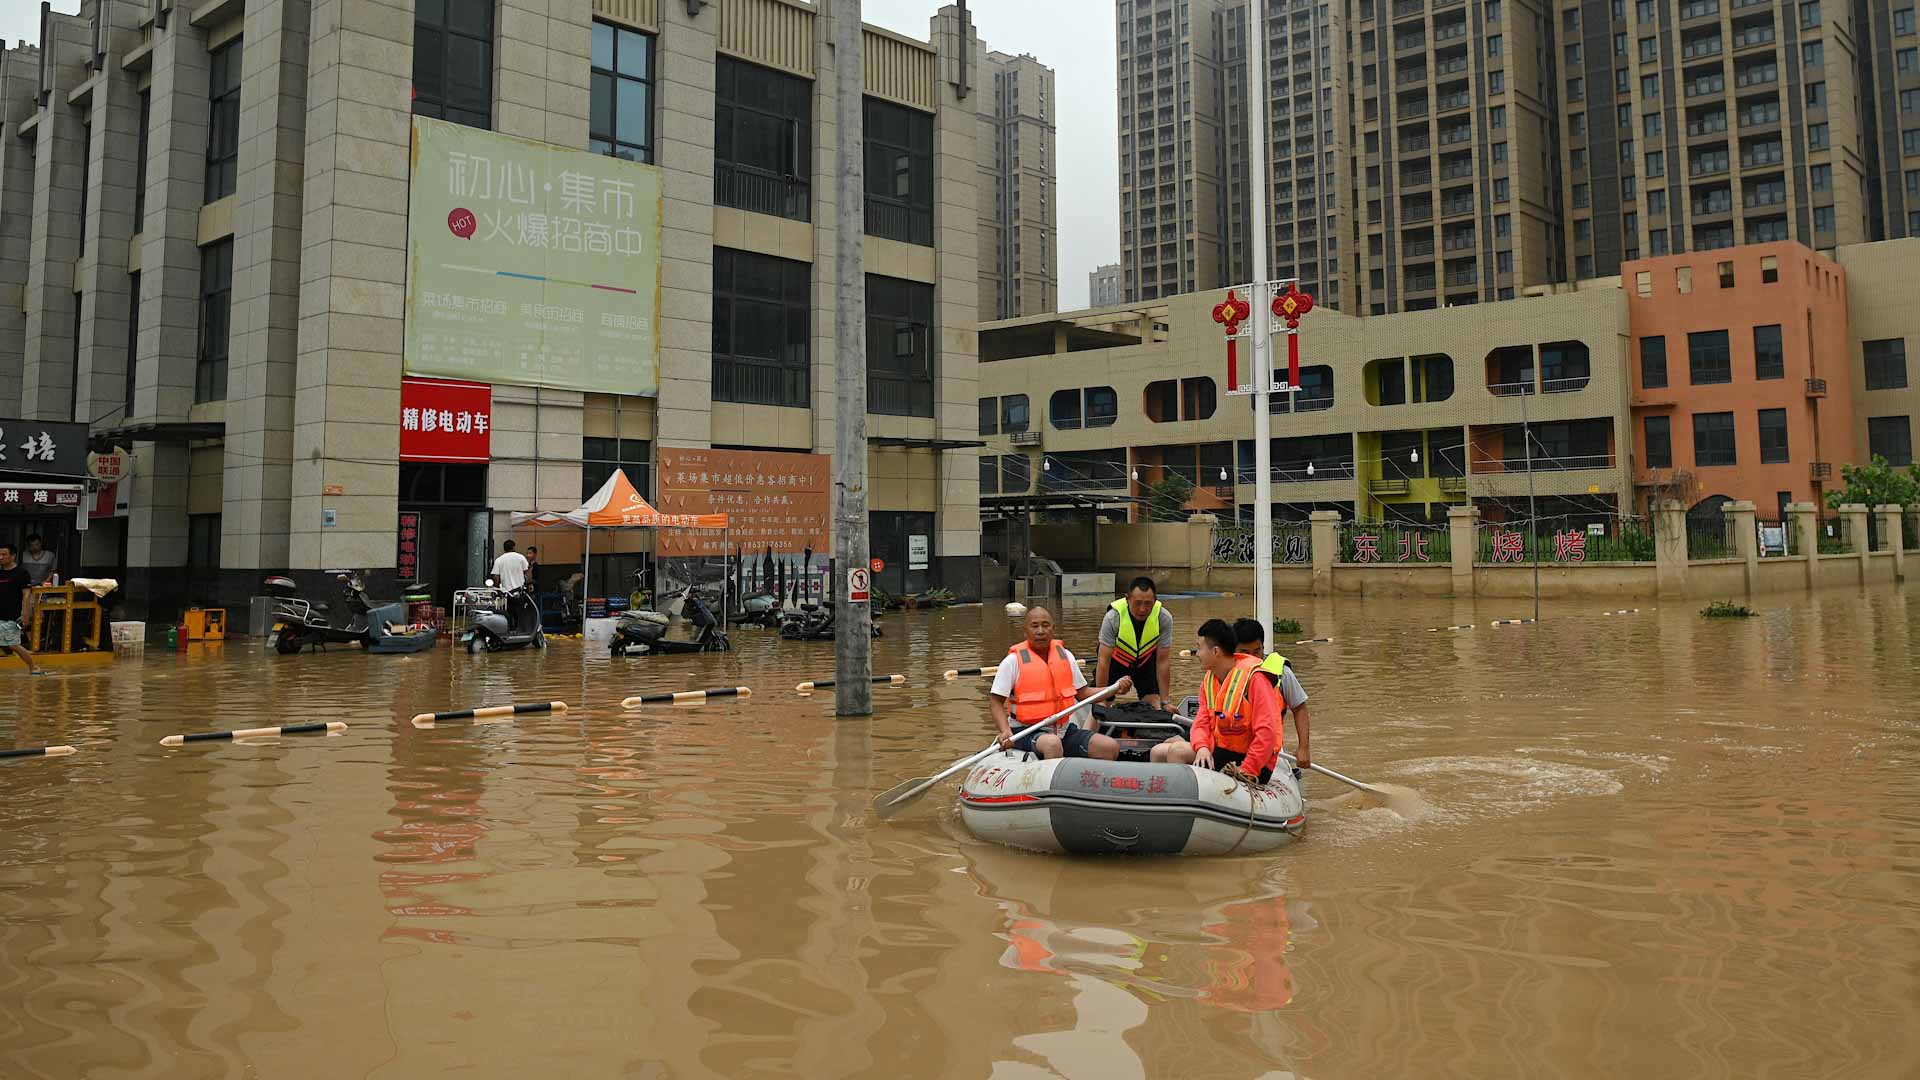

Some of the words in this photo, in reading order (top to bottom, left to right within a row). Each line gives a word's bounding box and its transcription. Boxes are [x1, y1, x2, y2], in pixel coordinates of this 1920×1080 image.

[451, 215, 472, 232] HOT
[483, 209, 642, 257] 火爆招商中
[402, 407, 489, 435] 精修电动车
[97, 466, 120, 476] 联通
[98, 456, 121, 466] 中国
[3, 490, 49, 503] 烘焙
[399, 514, 417, 578] 精修电动车
[1353, 532, 1430, 563] 东北
[1491, 529, 1586, 563] 烧烤
